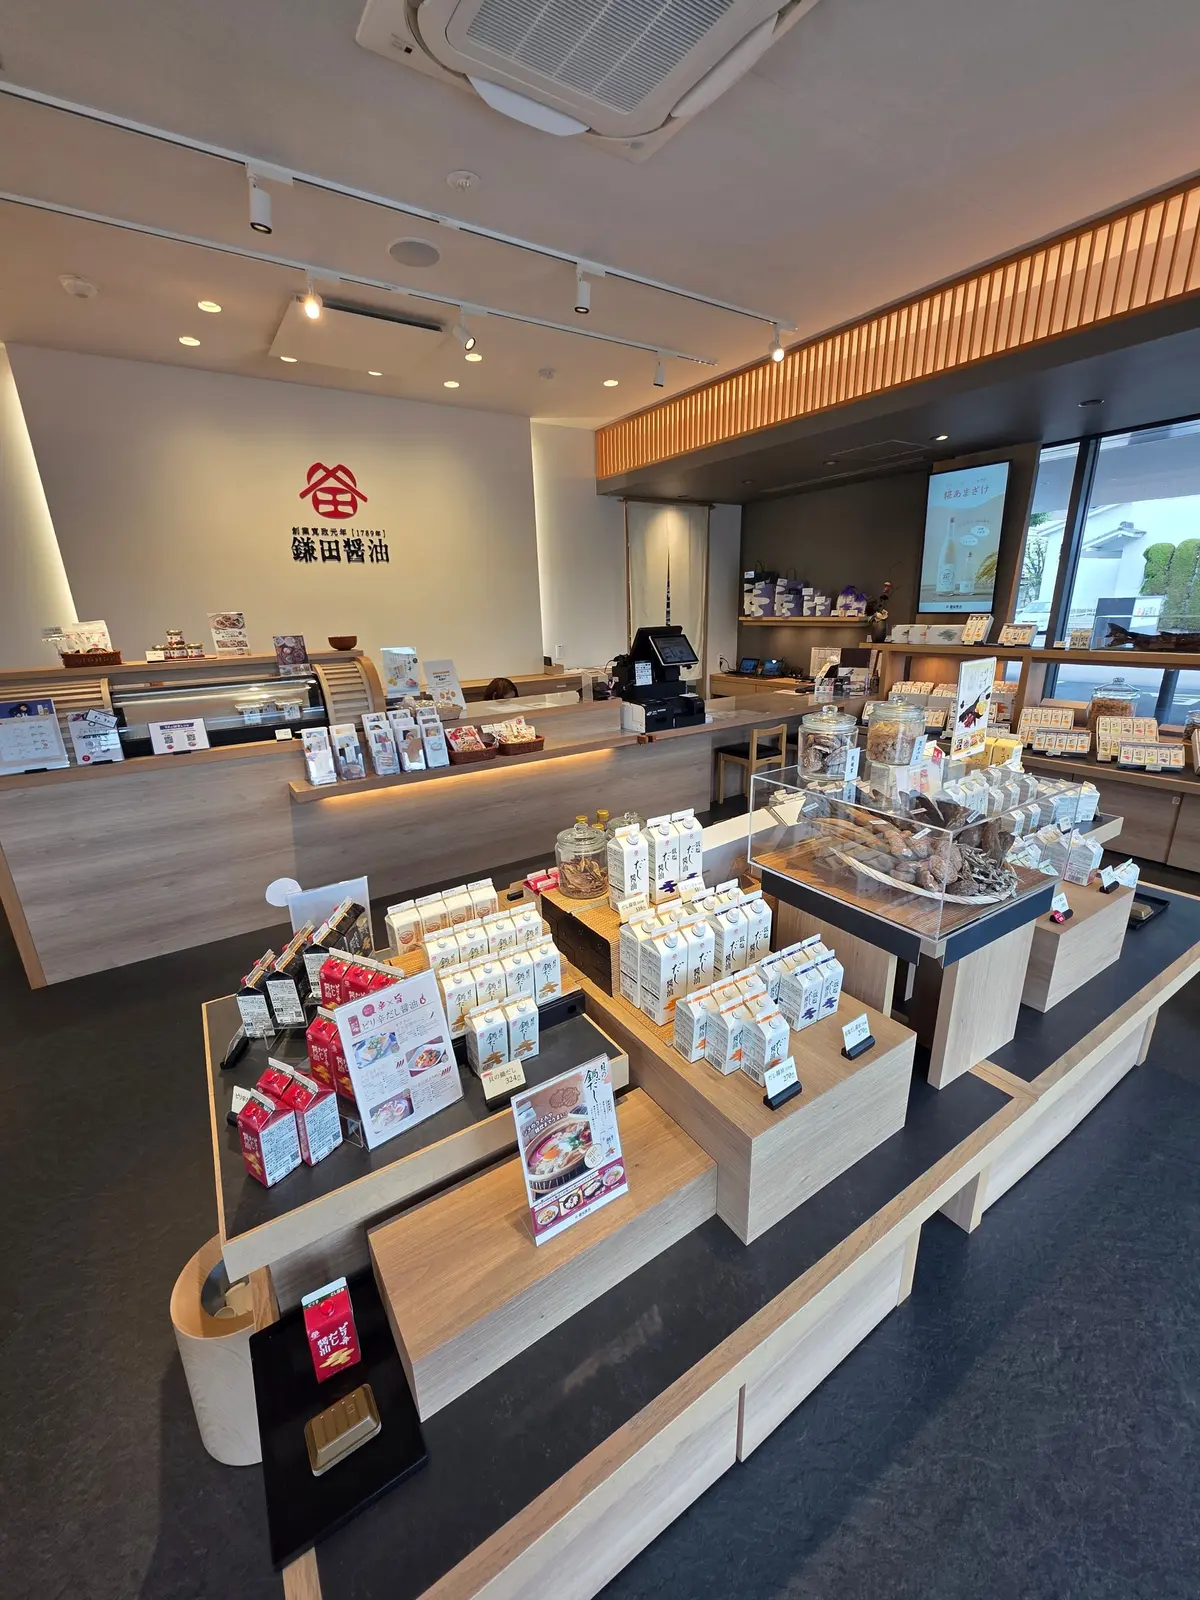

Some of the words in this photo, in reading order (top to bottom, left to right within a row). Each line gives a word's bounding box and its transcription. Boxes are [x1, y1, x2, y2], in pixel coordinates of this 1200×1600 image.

[290, 536, 390, 563] 鎌田醤油
[362, 1000, 419, 1029] ピリ辛だし醤油
[488, 1067, 516, 1083] 貝の鍋だし
[584, 1068, 601, 1103] 鍋だし
[329, 1331, 340, 1346] だし
